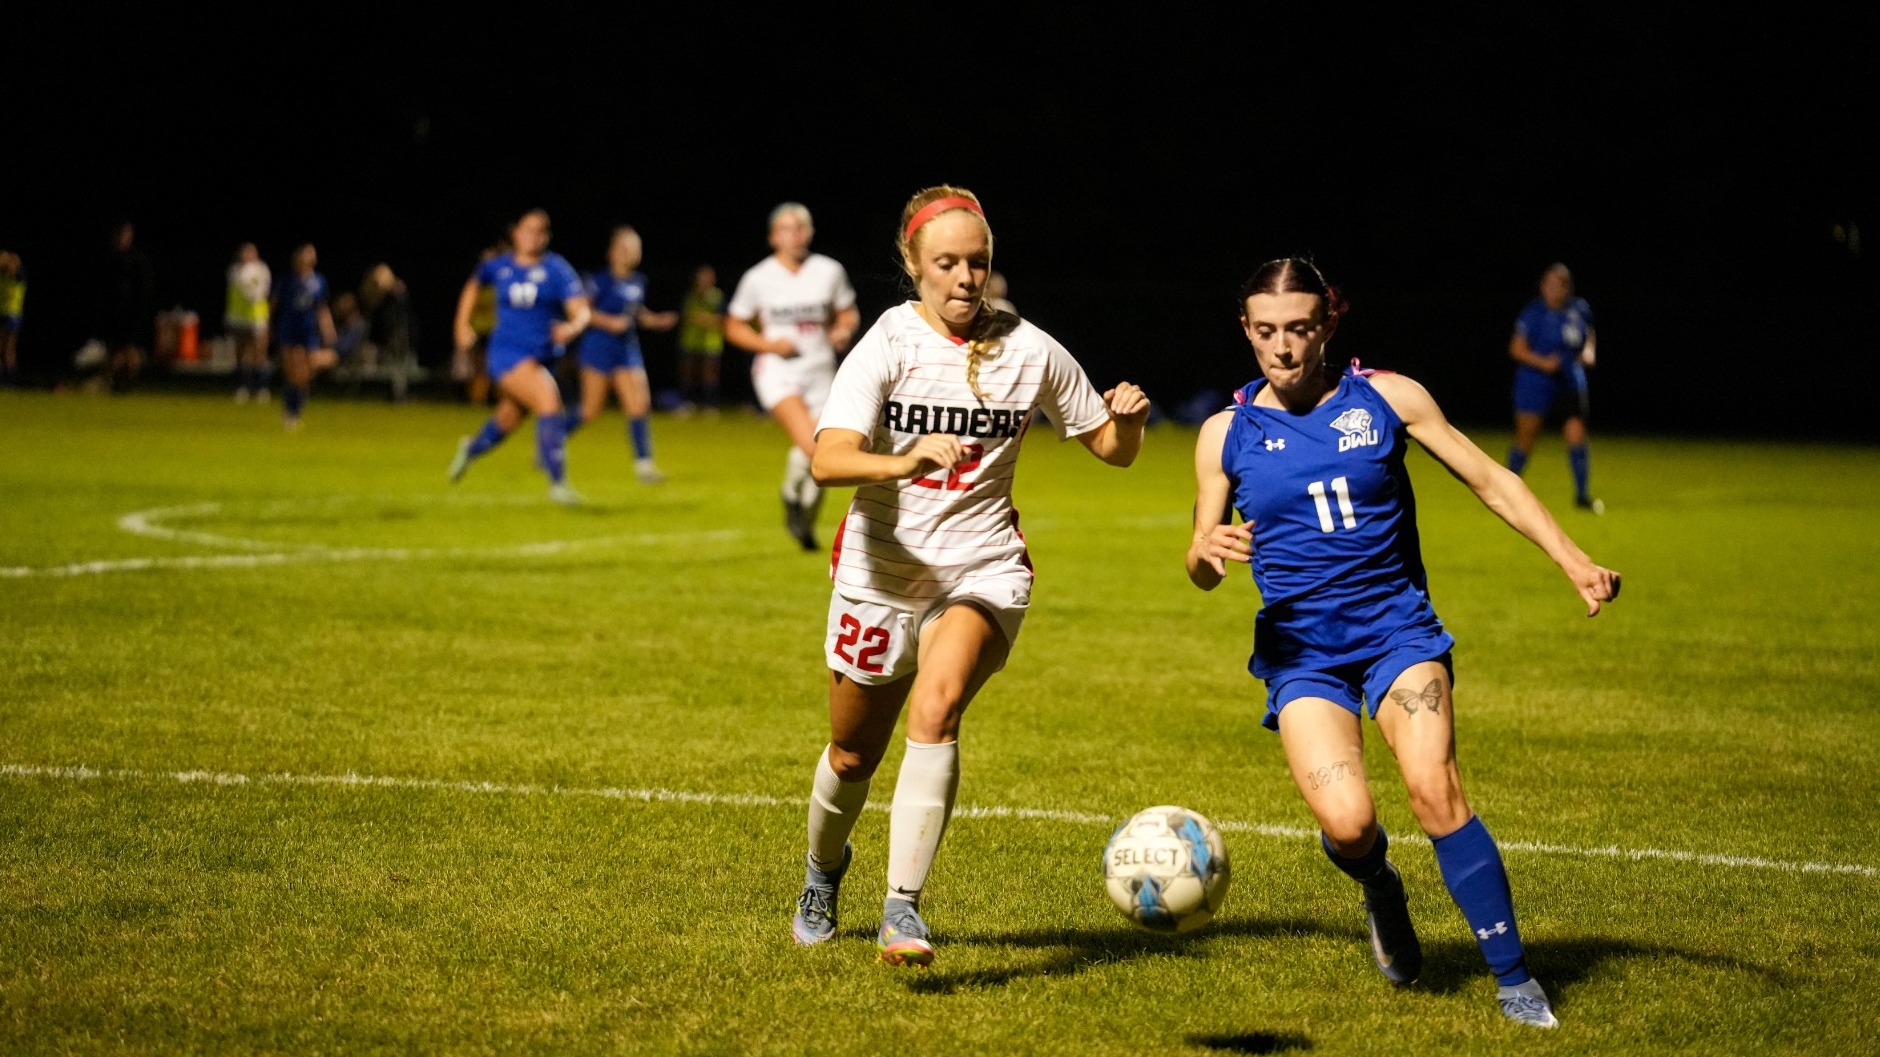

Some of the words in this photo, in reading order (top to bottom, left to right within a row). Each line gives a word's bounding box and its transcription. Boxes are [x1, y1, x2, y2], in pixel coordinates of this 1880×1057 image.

[884, 400, 1029, 439] RAIDERS
[1338, 429, 1379, 453] DWU
[1307, 476, 1357, 534] 11
[833, 612, 891, 674] 22
[1307, 760, 1357, 790] 1971
[1114, 848, 1179, 867] SELECT
